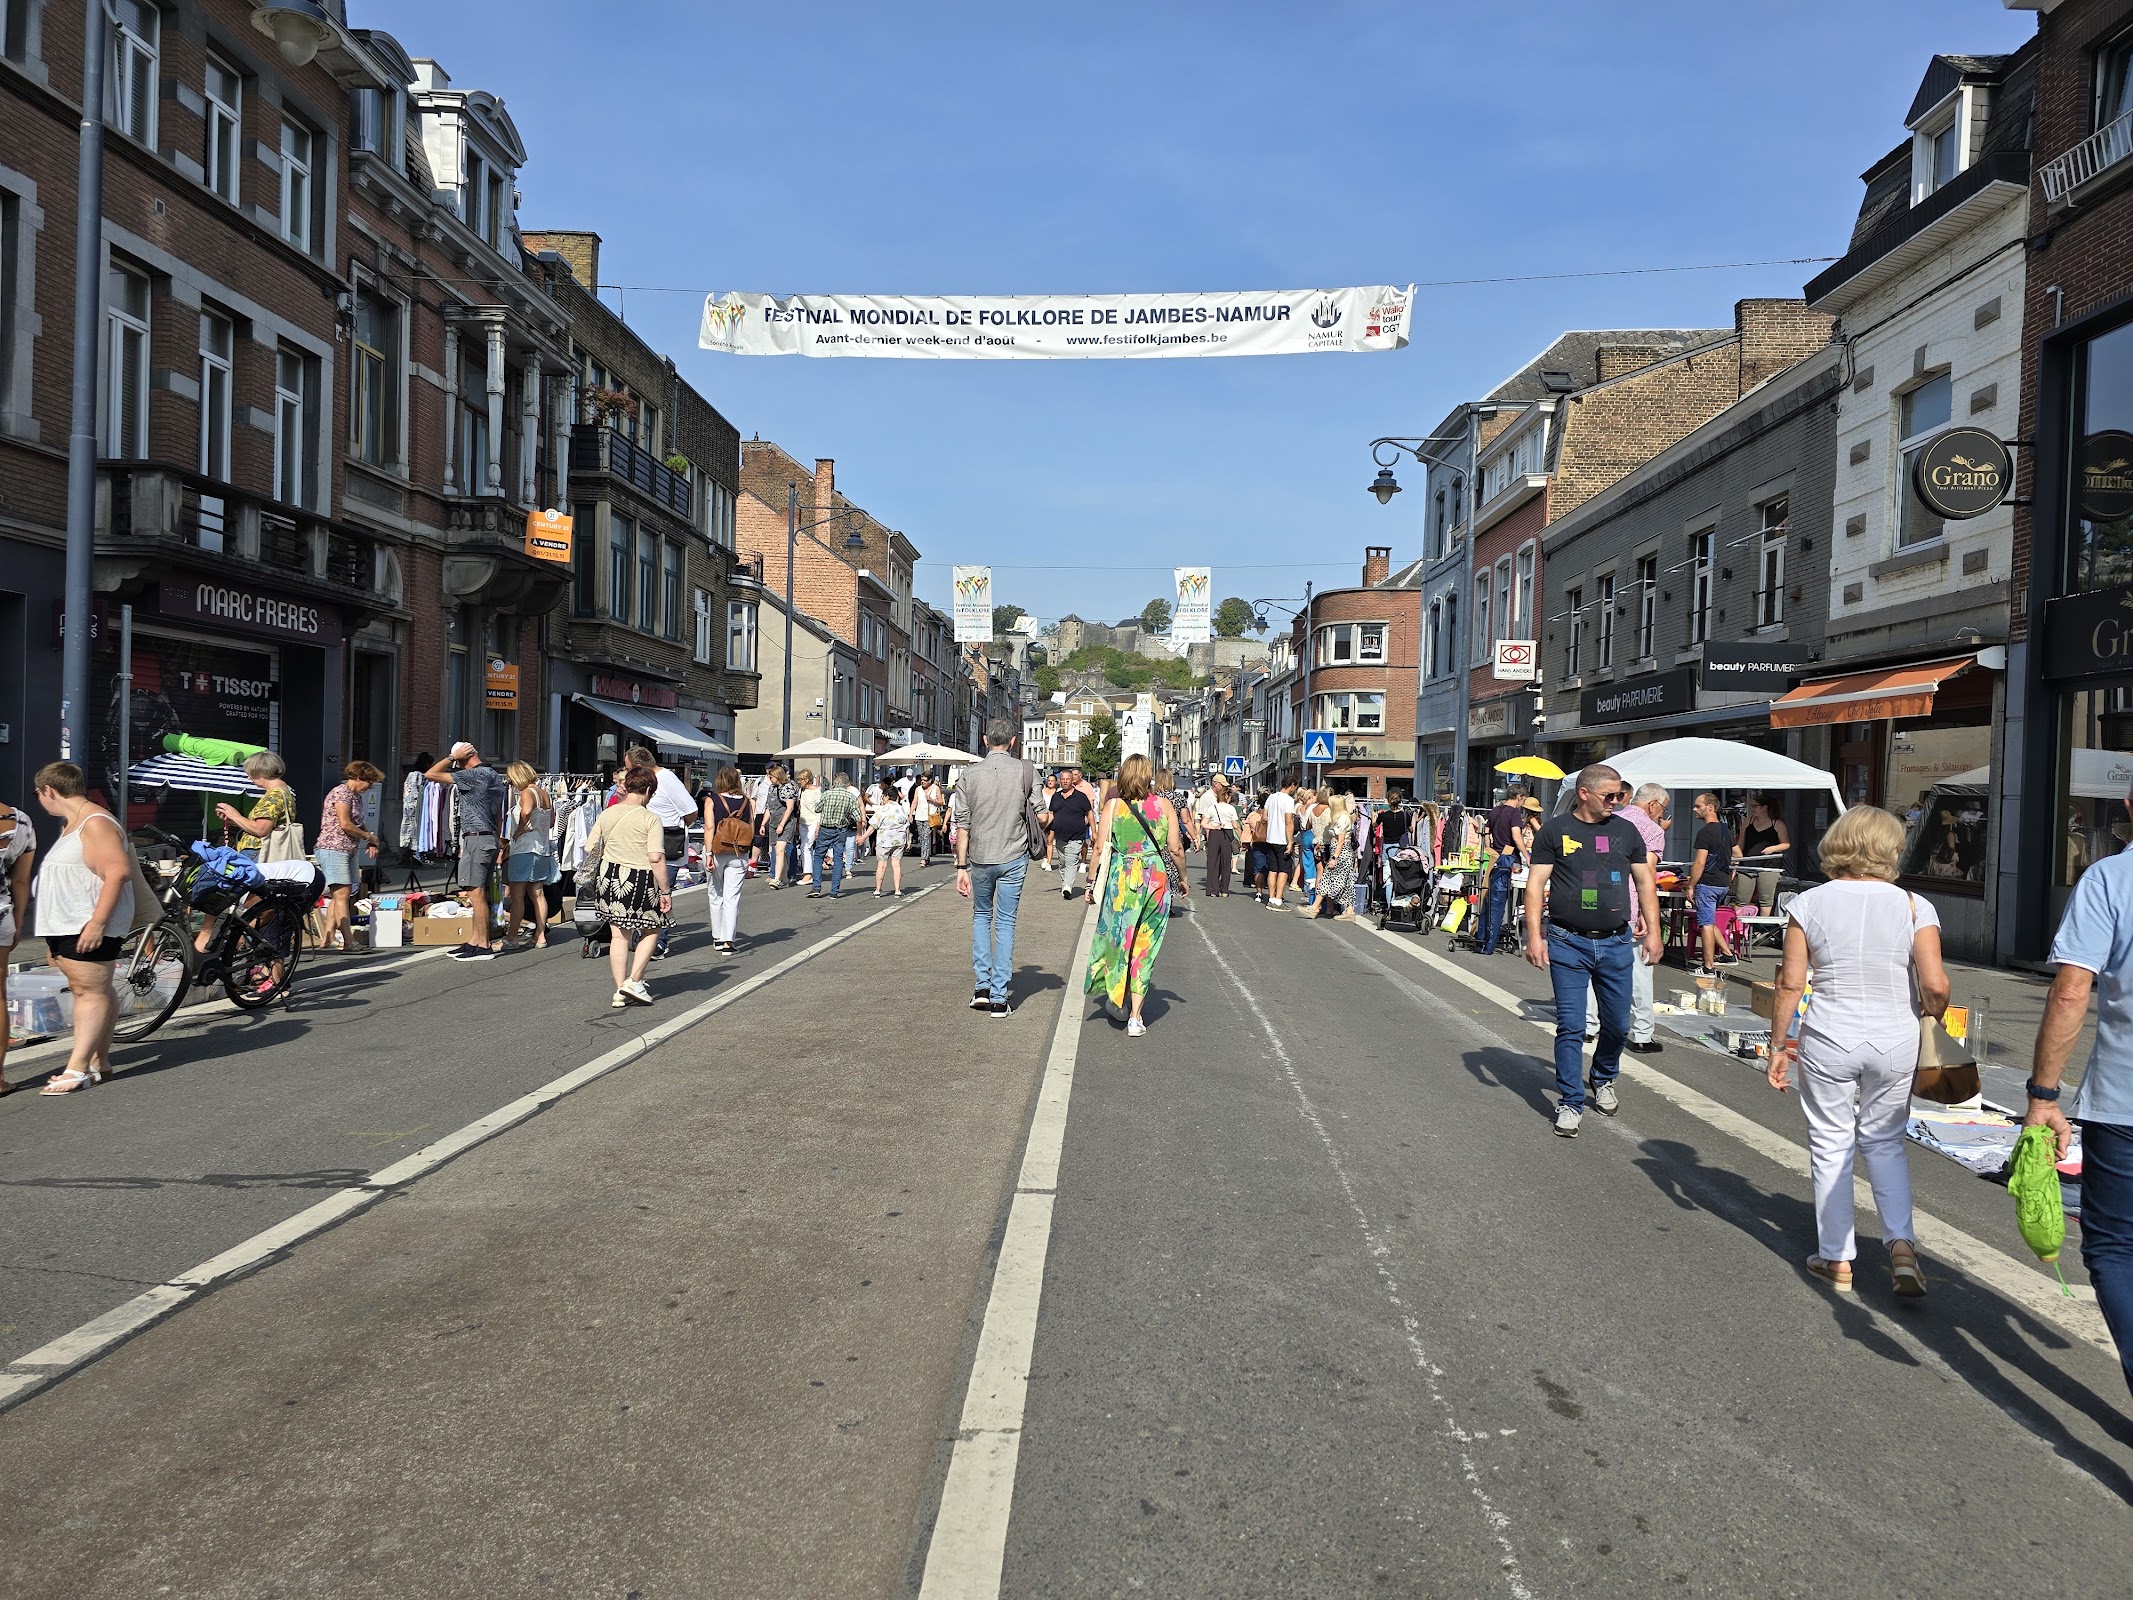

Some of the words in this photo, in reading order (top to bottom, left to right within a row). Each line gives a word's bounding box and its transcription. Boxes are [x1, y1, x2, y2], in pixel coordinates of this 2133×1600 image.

[850, 309, 939, 325] MONDIAL
[946, 310, 972, 325] DE
[979, 309, 1084, 325] FOLKLORE
[1091, 309, 1118, 324] DE
[1124, 305, 1291, 324] JAMBES-NAMUR
[816, 334, 902, 346] Avant-dernier
[907, 335, 970, 346] week-end
[974, 335, 1015, 346] d'août
[1067, 332, 1228, 347] www.festifolkjambes.be
[1308, 330, 1343, 340] NAMUR
[1308, 339, 1344, 348] CAPITALE
[1931, 466, 2000, 486] Grano
[532, 521, 562, 530] CENTURY
[539, 540, 567, 550] VENDRE
[196, 583, 253, 622] MARC
[255, 597, 319, 634] FRERES
[1709, 661, 1746, 673] beauty
[1747, 662, 1802, 673] PARFUMER
[212, 675, 272, 699] TISSOT
[487, 690, 515, 698] VENDRE
[1597, 693, 1622, 713] beauty
[1622, 685, 1664, 709] PARFUMERIE
[218, 702, 244, 712] POWERED
[1847, 701, 1864, 718] Chez
[225, 710, 248, 718] CRAFTED
[1336, 745, 1367, 757] EM
[1900, 763, 1930, 774] Fromages
[1933, 762, 1940, 772] &
[1941, 761, 1973, 772] Salaisons
